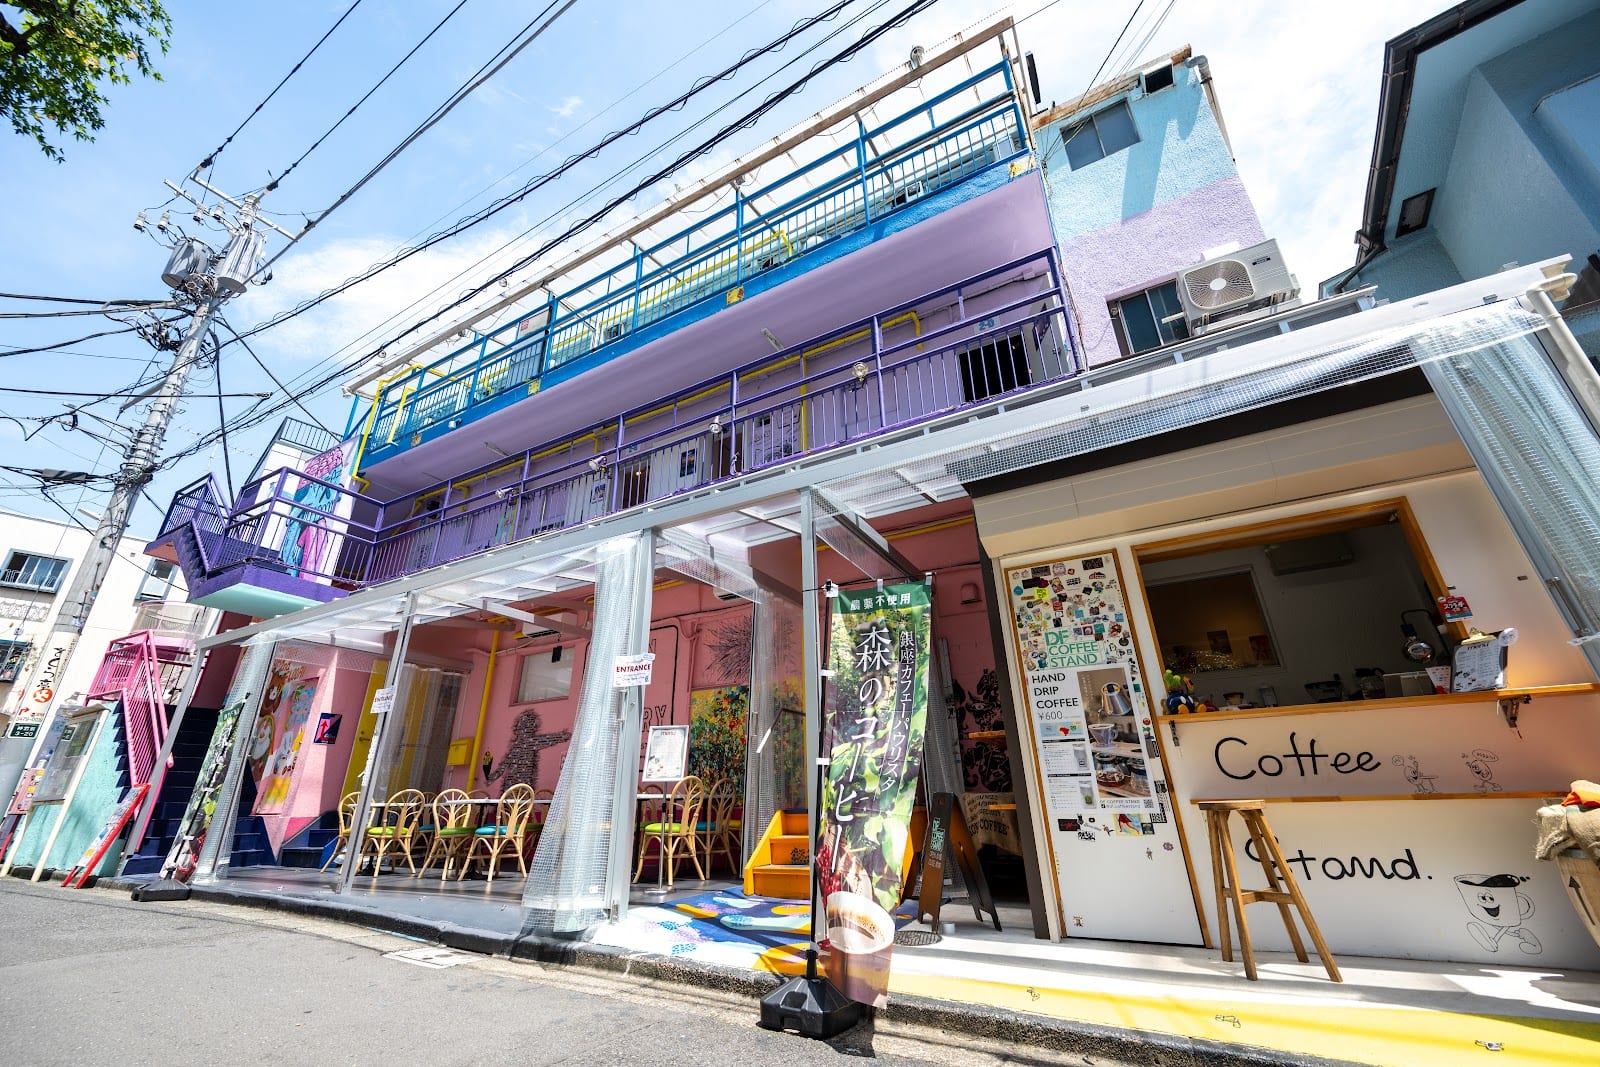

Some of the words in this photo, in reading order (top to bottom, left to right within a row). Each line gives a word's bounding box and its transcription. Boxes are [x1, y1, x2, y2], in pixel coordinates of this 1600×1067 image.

[850, 592, 911, 611] 農薬不使用
[1044, 630, 1071, 646] DF
[1048, 641, 1099, 656] COFFEE
[616, 663, 651, 673] ENTRANCE
[1050, 653, 1098, 669] STAND
[1031, 672, 1066, 684] HAND
[1033, 685, 1059, 697] DRIP
[880, 630, 915, 791] 銀座カフェーパウリスタ
[1036, 697, 1079, 709] COFFEE
[1037, 711, 1063, 720] ¥600
[831, 626, 892, 873] 森のコーヒー
[1214, 731, 1381, 780] Coffee
